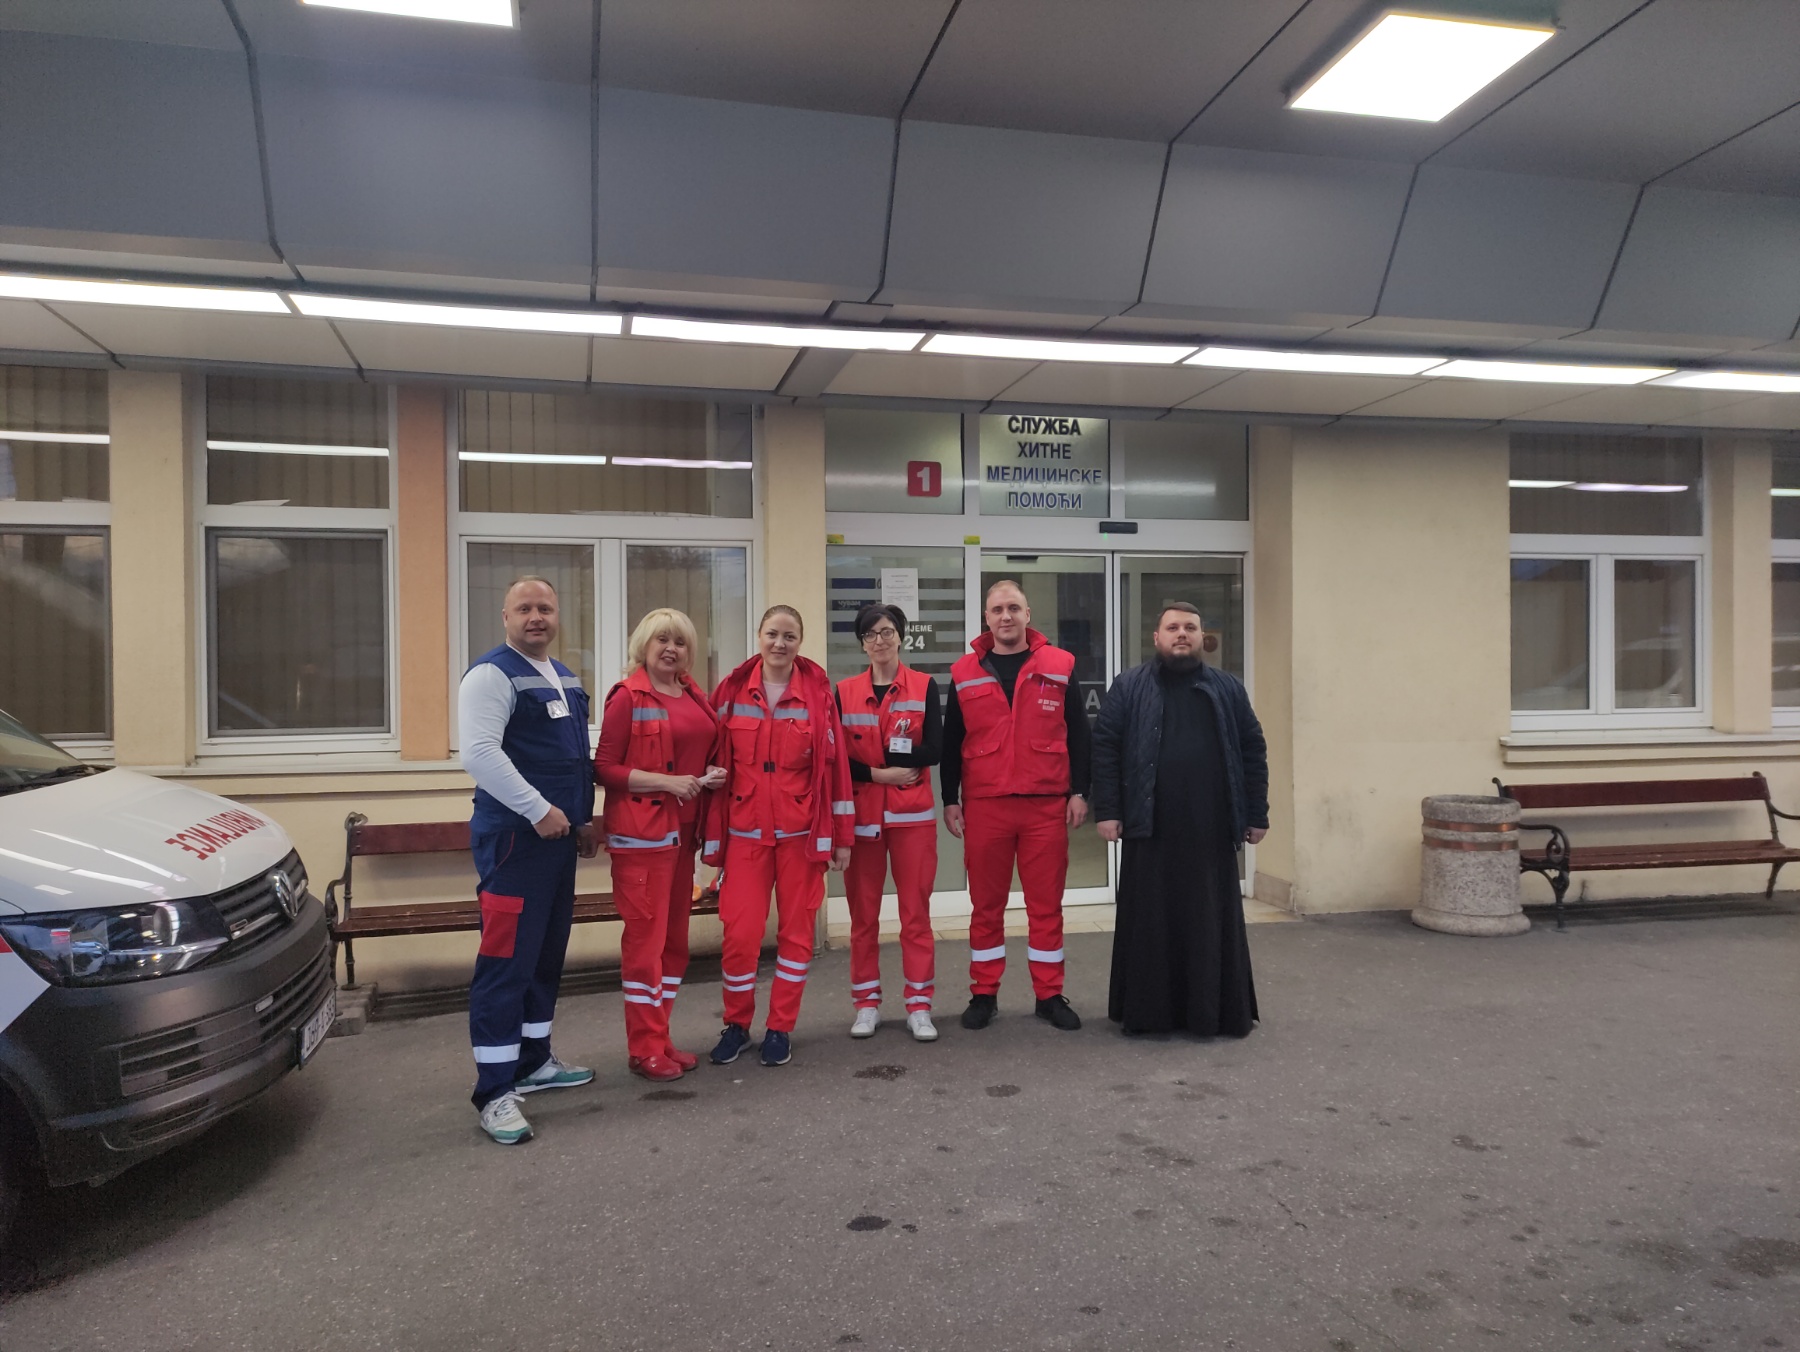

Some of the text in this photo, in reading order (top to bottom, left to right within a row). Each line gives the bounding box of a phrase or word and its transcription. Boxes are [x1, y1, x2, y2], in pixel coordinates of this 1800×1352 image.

[1008, 415, 1082, 436] СЛУЖБА
[1018, 441, 1072, 460] ХИТНЕ
[916, 466, 930, 492] 1
[986, 465, 1102, 487] МЕДИЦИНСКЕ
[1008, 491, 1082, 509] ПОМОЋИ
[904, 624, 933, 633] ИЈЕМЕ
